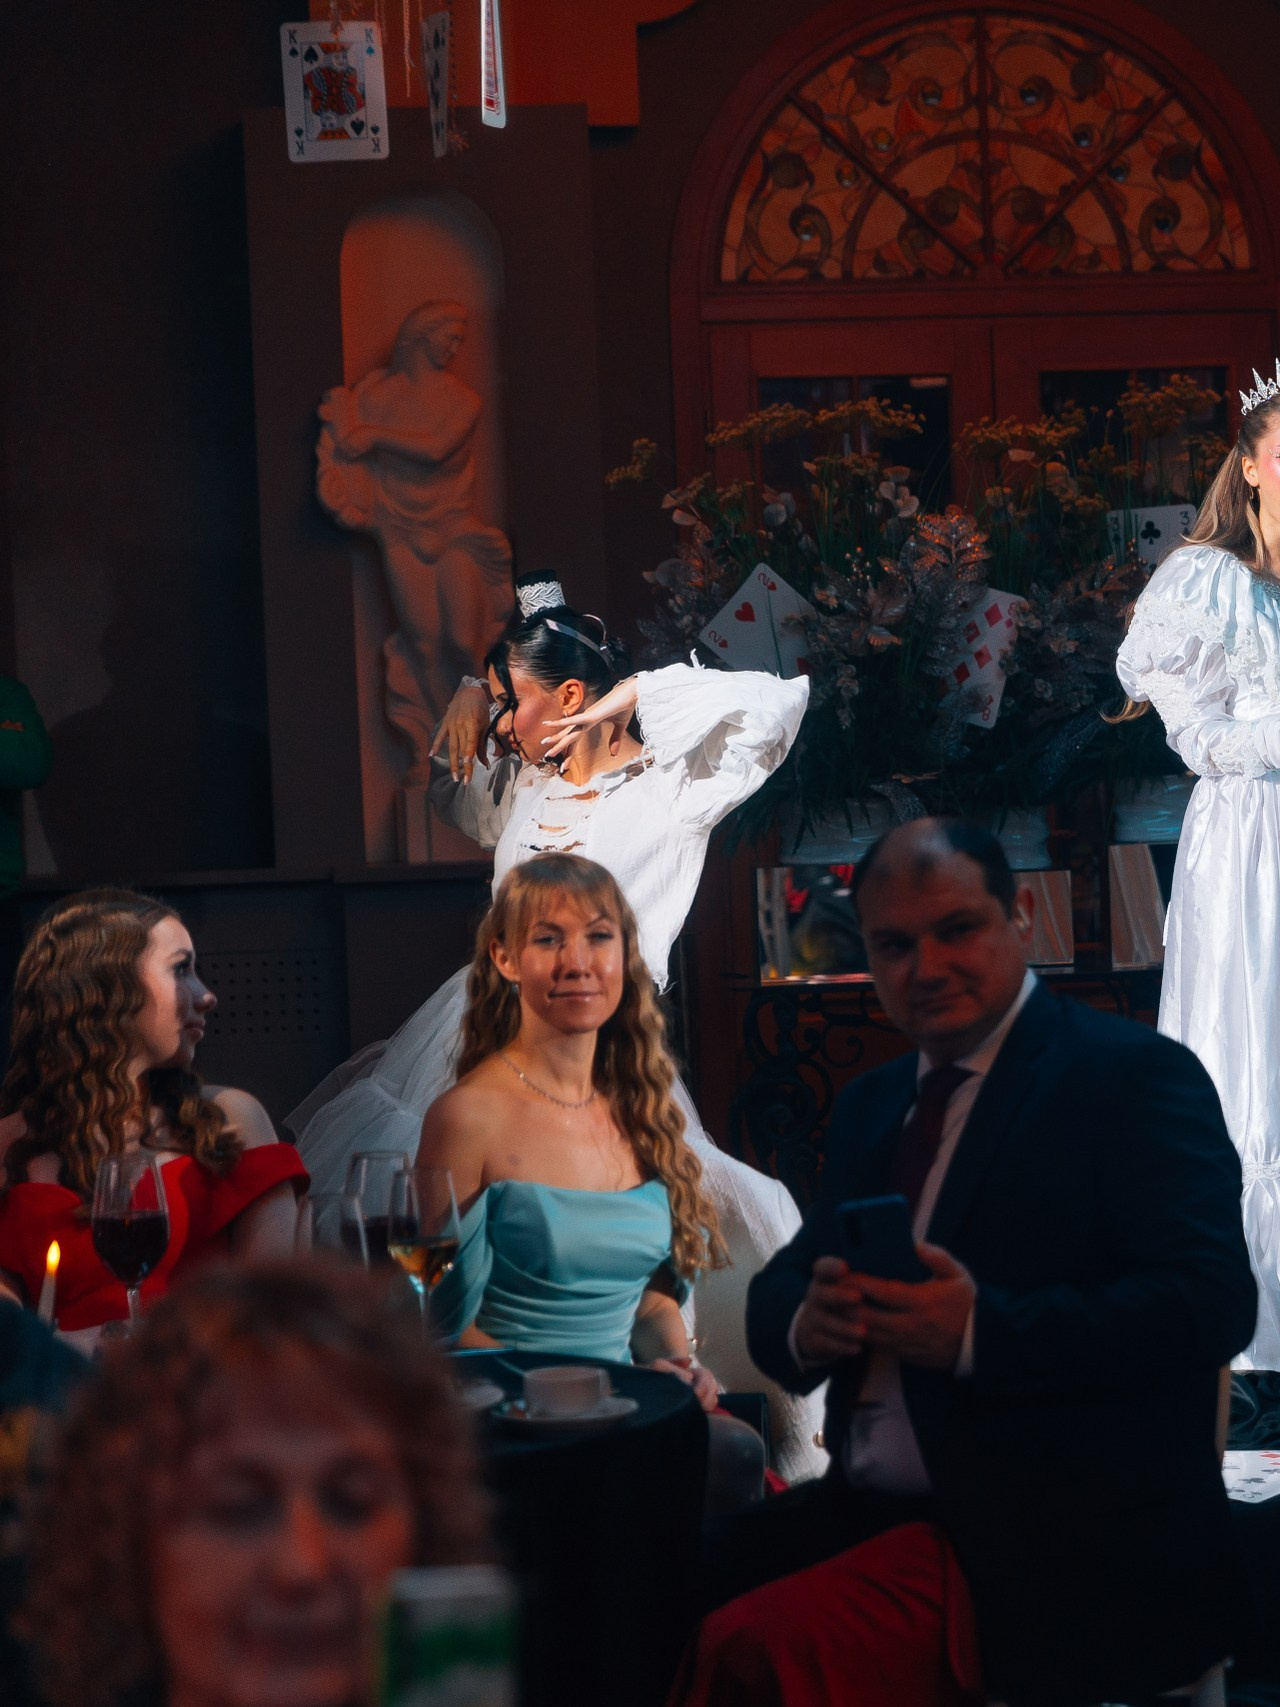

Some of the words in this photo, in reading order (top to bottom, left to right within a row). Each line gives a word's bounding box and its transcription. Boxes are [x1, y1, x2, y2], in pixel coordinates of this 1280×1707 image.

[288, 28, 298, 44] K
[1110, 516, 1120, 532] 3
[1180, 511, 1190, 526] 3
[708, 630, 721, 644] 2
[982, 708, 990, 721] 8
